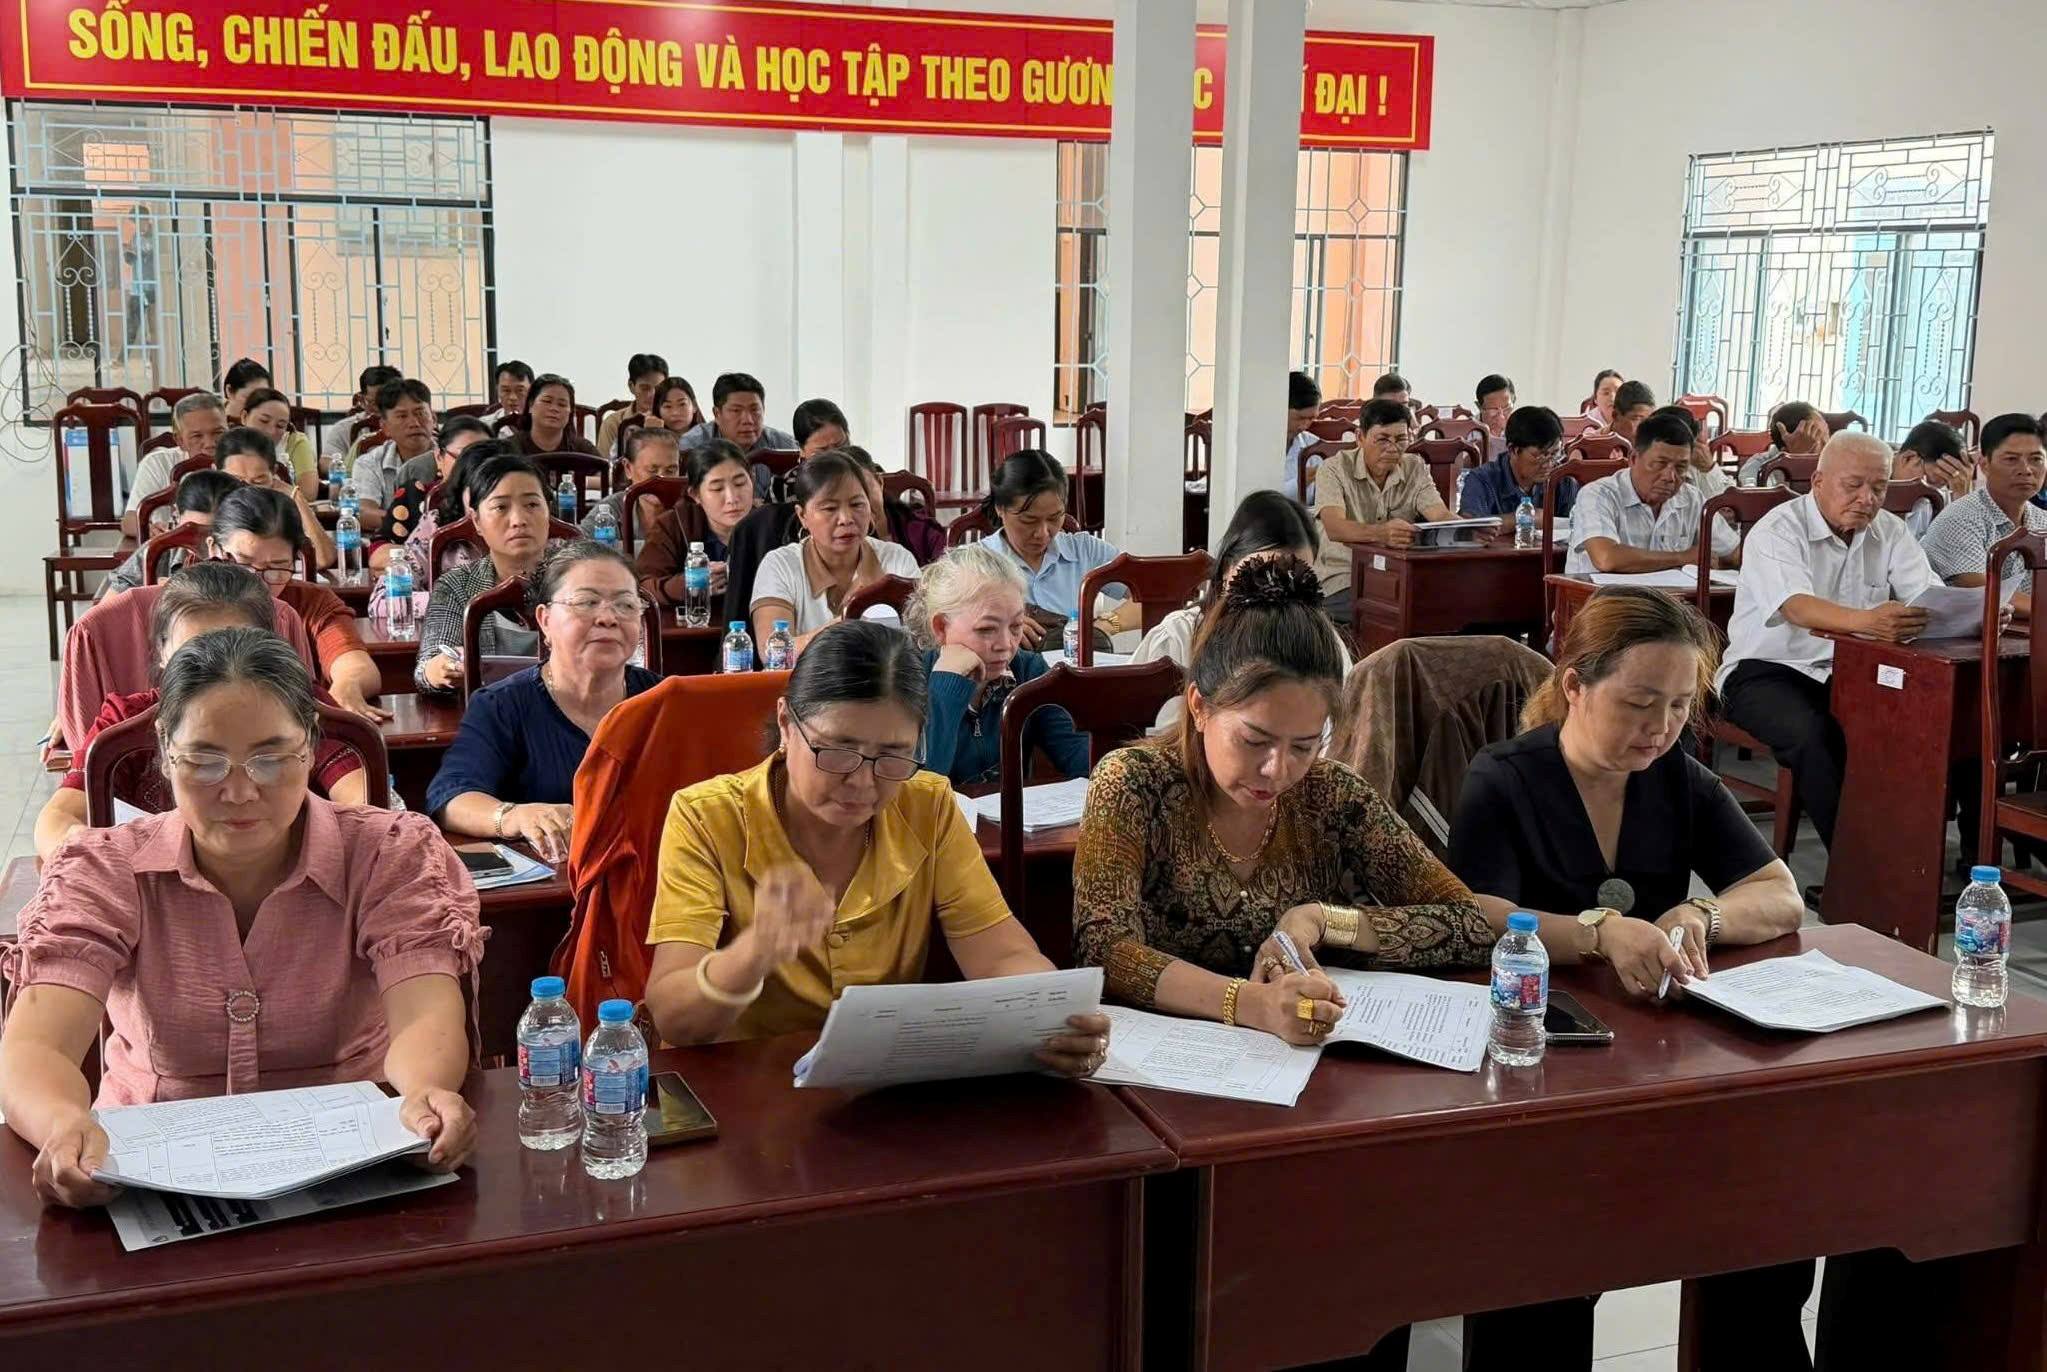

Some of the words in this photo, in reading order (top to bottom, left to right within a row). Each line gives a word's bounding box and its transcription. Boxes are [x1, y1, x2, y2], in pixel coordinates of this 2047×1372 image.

[68, 0, 209, 68] SỐNG,
[223, 4, 359, 69] CHIẾN
[371, 10, 470, 81] ĐẤU,
[485, 29, 560, 80] LAO
[573, 27, 683, 94] ĐỘNG
[695, 34, 746, 90] VÀ
[757, 46, 831, 103] HỌC
[842, 42, 910, 106] TẬP
[921, 55, 1010, 102] THEO
[1022, 55, 1114, 106] GƯƠN
[1315, 72, 1368, 124] ĐẠI
